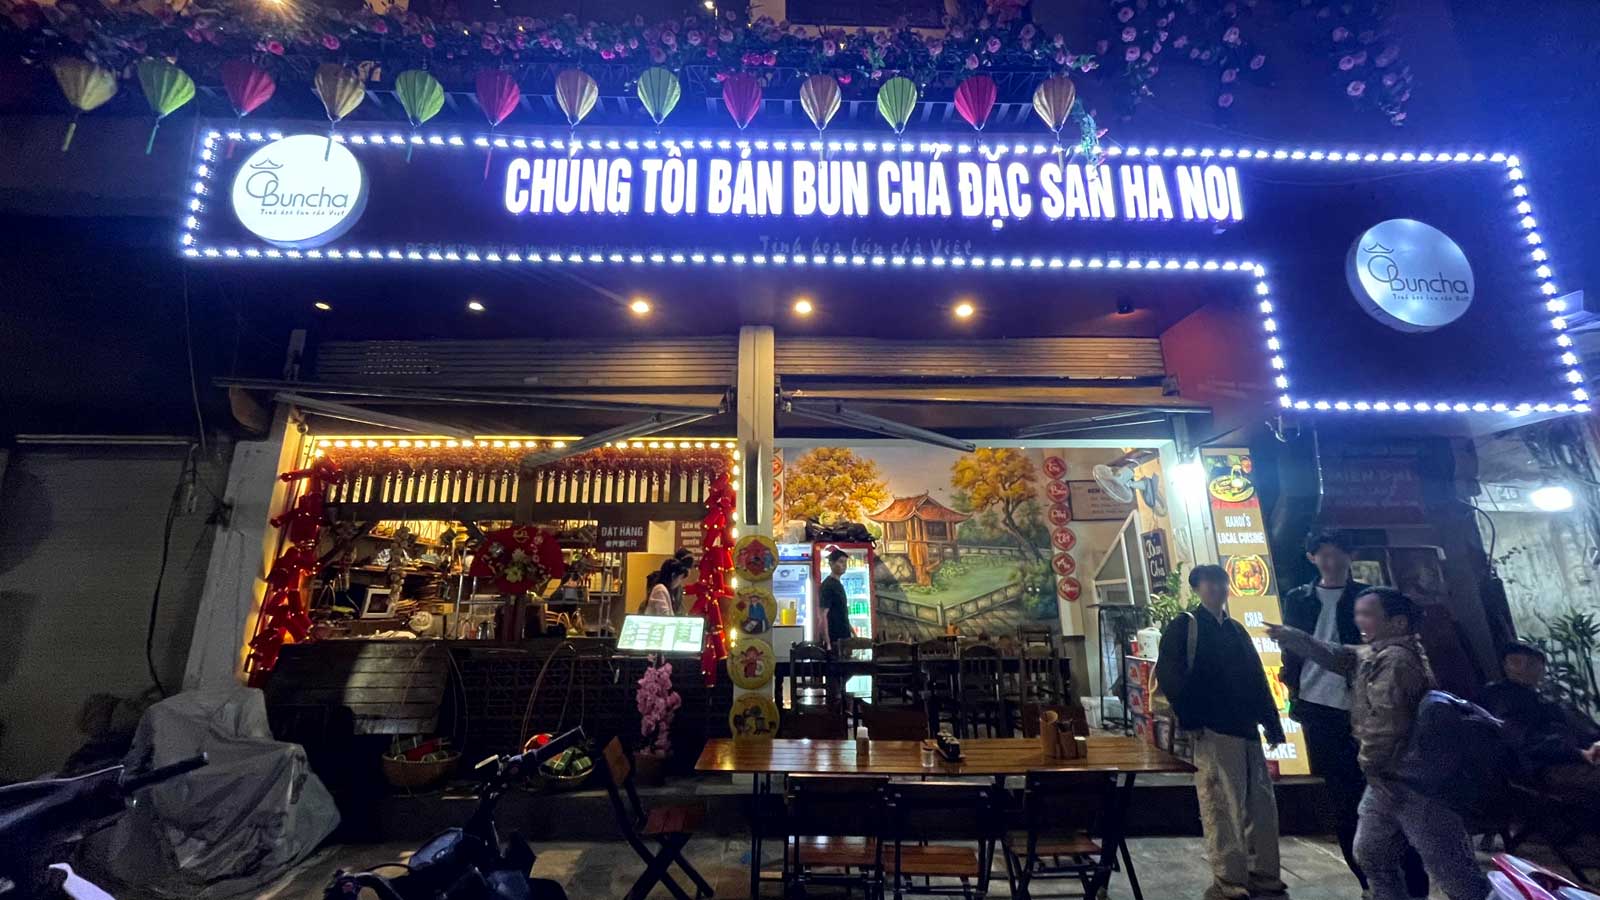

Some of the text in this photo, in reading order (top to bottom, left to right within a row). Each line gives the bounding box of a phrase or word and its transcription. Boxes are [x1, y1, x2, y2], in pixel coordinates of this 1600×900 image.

[261, 180, 349, 208] Buncha
[641, 146, 698, 215] TÔI
[707, 147, 783, 215] BÁN
[957, 148, 1032, 228] ĐẶC
[1387, 264, 1469, 294] Buncha
[1244, 611, 1264, 627] CRAB
